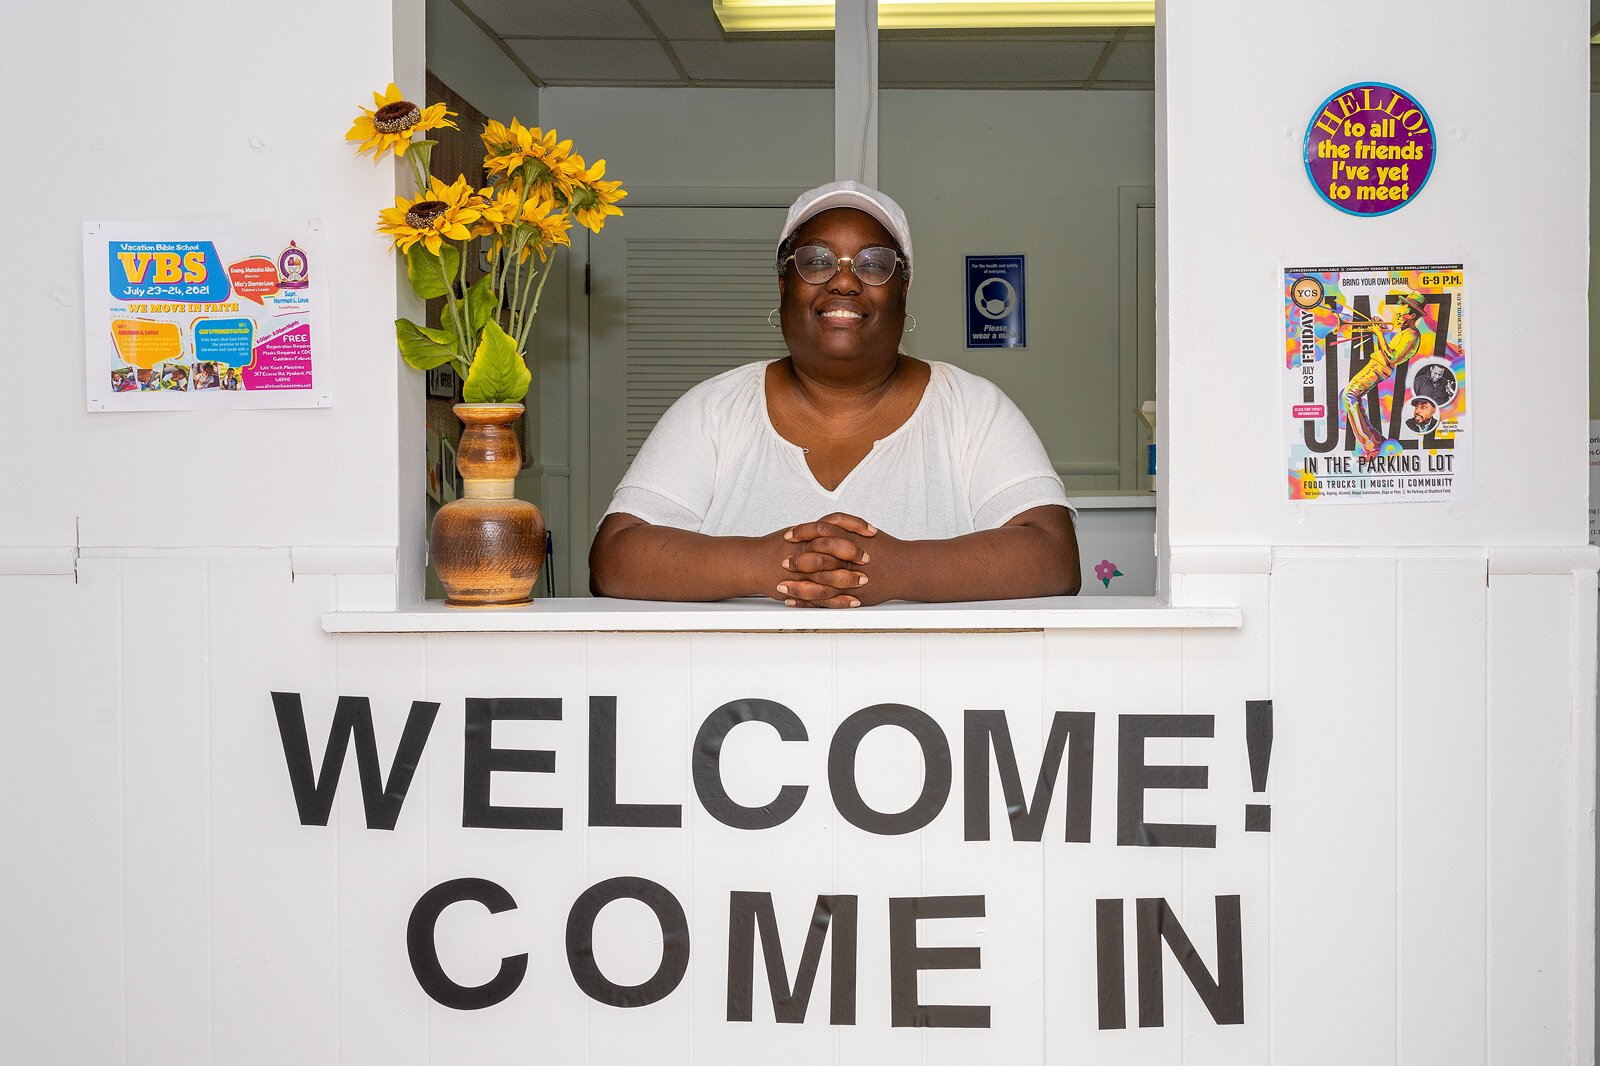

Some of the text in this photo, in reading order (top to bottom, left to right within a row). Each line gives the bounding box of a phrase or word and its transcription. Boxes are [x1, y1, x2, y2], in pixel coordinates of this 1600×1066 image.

[1314, 88, 1429, 139] HELLO!
[1344, 118, 1396, 138] to all
[1318, 139, 1424, 160] the friends
[1332, 161, 1409, 185] I've yet
[1329, 182, 1409, 201] to meet
[120, 243, 155, 251] Vacation
[156, 243, 175, 251] Bible
[117, 251, 208, 285] VBS
[1342, 277, 1409, 287] BRING YOUR OWN CHAIR
[1422, 275, 1462, 285] 6-9 P.M.
[123, 286, 145, 297] July
[185, 286, 210, 295] 2021
[1297, 289, 1318, 298] YCS
[127, 303, 240, 313] WE MOVE IN FAITH
[283, 334, 308, 343] FREE
[1302, 310, 1314, 364] FRIDAY
[1302, 366, 1315, 375] JULY
[1303, 375, 1315, 385] 23
[1304, 454, 1455, 474] IN THE PARKING LOT
[1303, 480, 1323, 489] FOOD
[1326, 479, 1356, 488] TRUCKS
[1370, 479, 1394, 488] MUSIC
[1407, 478, 1453, 487] COMMUNITY
[270, 691, 1273, 848] WELCOME!
[406, 876, 1245, 1030] COME IN
